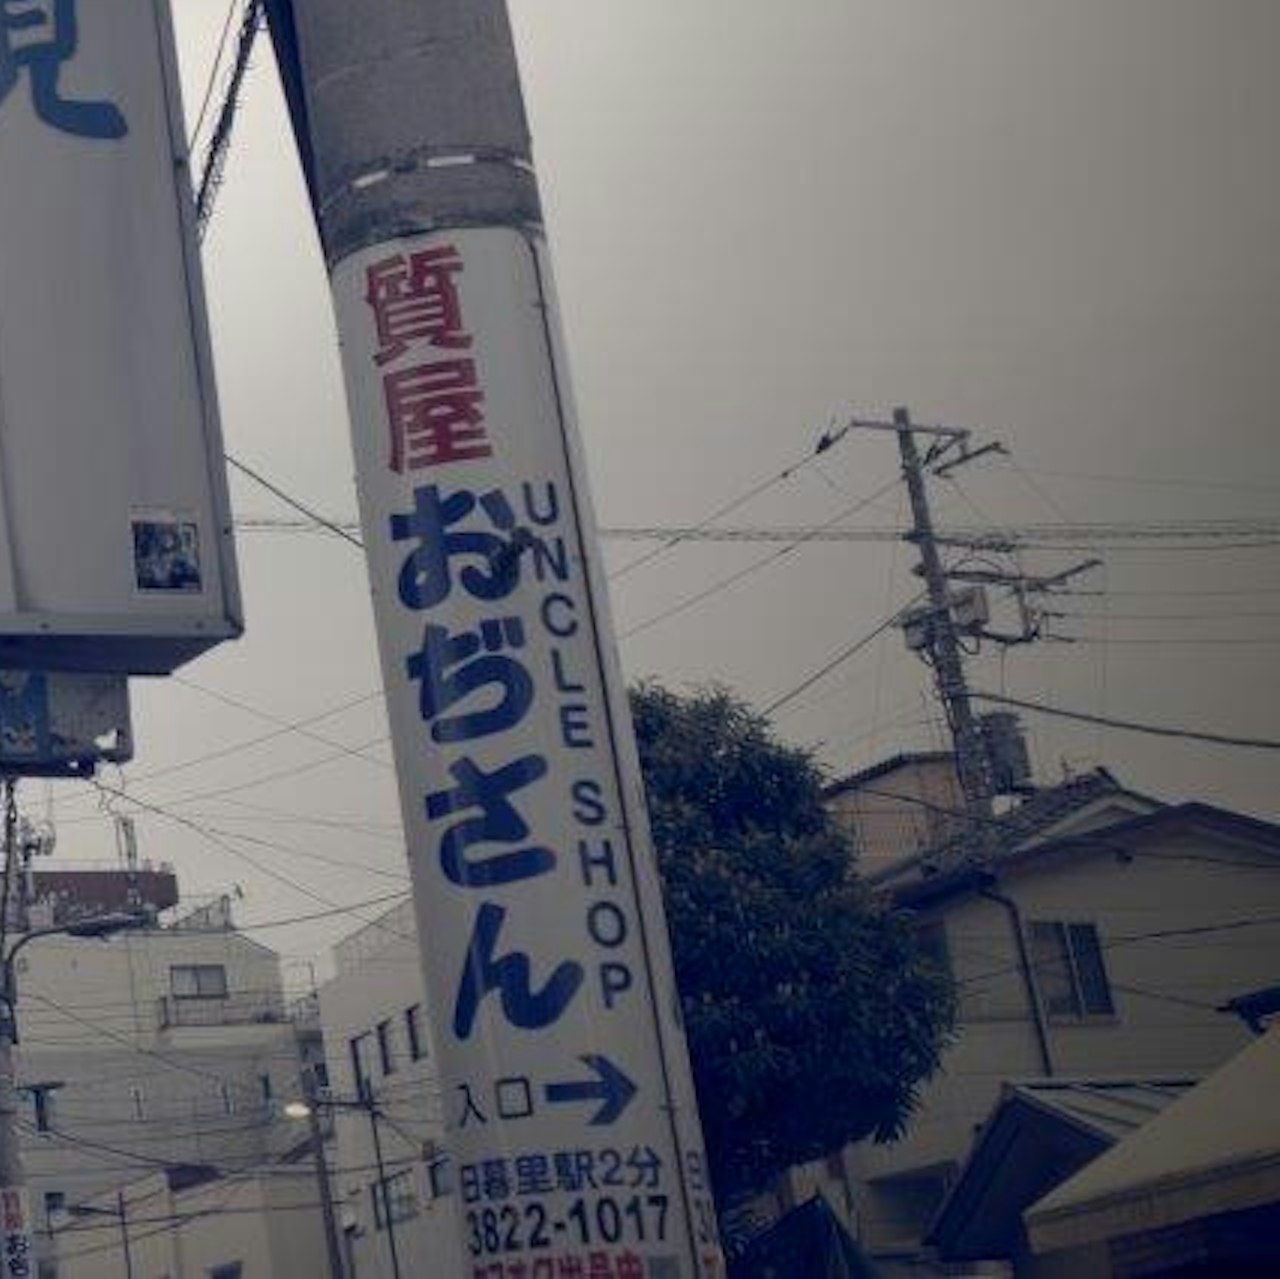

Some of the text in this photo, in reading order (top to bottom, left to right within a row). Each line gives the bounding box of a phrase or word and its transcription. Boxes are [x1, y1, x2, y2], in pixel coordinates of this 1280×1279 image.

[366, 244, 493, 475] 質屋
[389, 484, 585, 1041] おぢさん
[523, 482, 632, 1008] UNCLE SHOP
[459, 1077, 534, 1125] 入口
